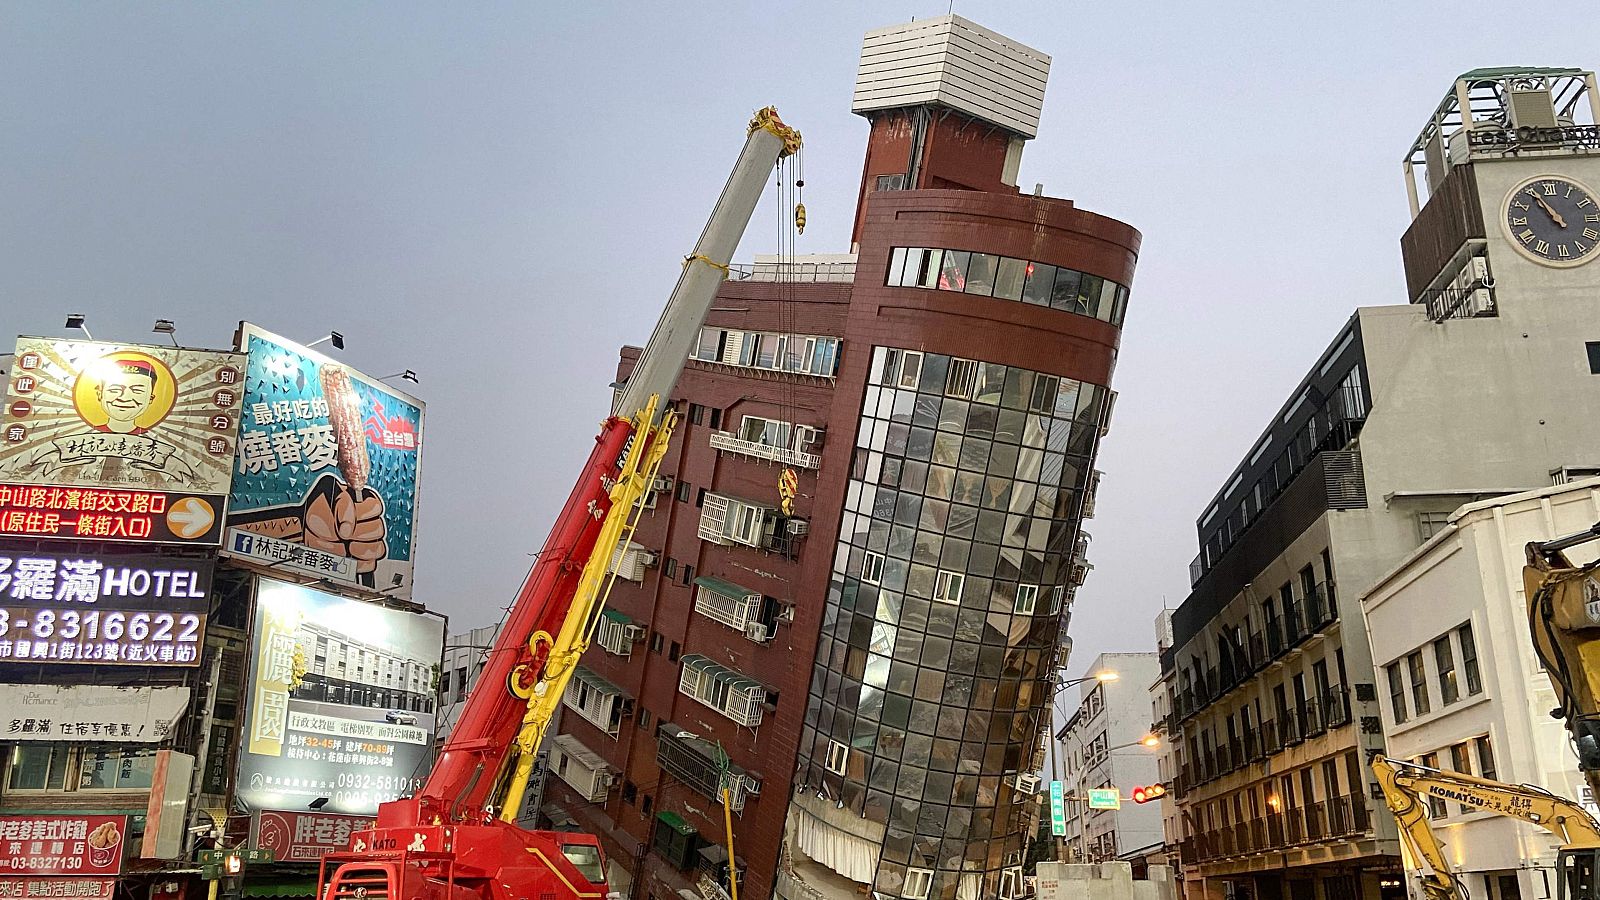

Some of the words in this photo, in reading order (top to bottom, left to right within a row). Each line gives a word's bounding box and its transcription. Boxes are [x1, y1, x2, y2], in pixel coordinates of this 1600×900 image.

[1542, 183, 1557, 196] XII
[9, 356, 38, 441] 僅此一家
[208, 370, 235, 454] 別無分號
[252, 399, 330, 426] 最好吃的
[237, 424, 339, 475] 燒番麥
[0, 487, 167, 514] 中山路北濱街交叉路口
[1, 510, 152, 538] (原住民一條街入口)
[9, 718, 51, 735] 多羅滿
[1429, 785, 1483, 806] KOMATSU
[0, 841, 85, 855] 來運轉店
[373, 838, 397, 850] KATO
[10, 856, 82, 870] 03-8327130
